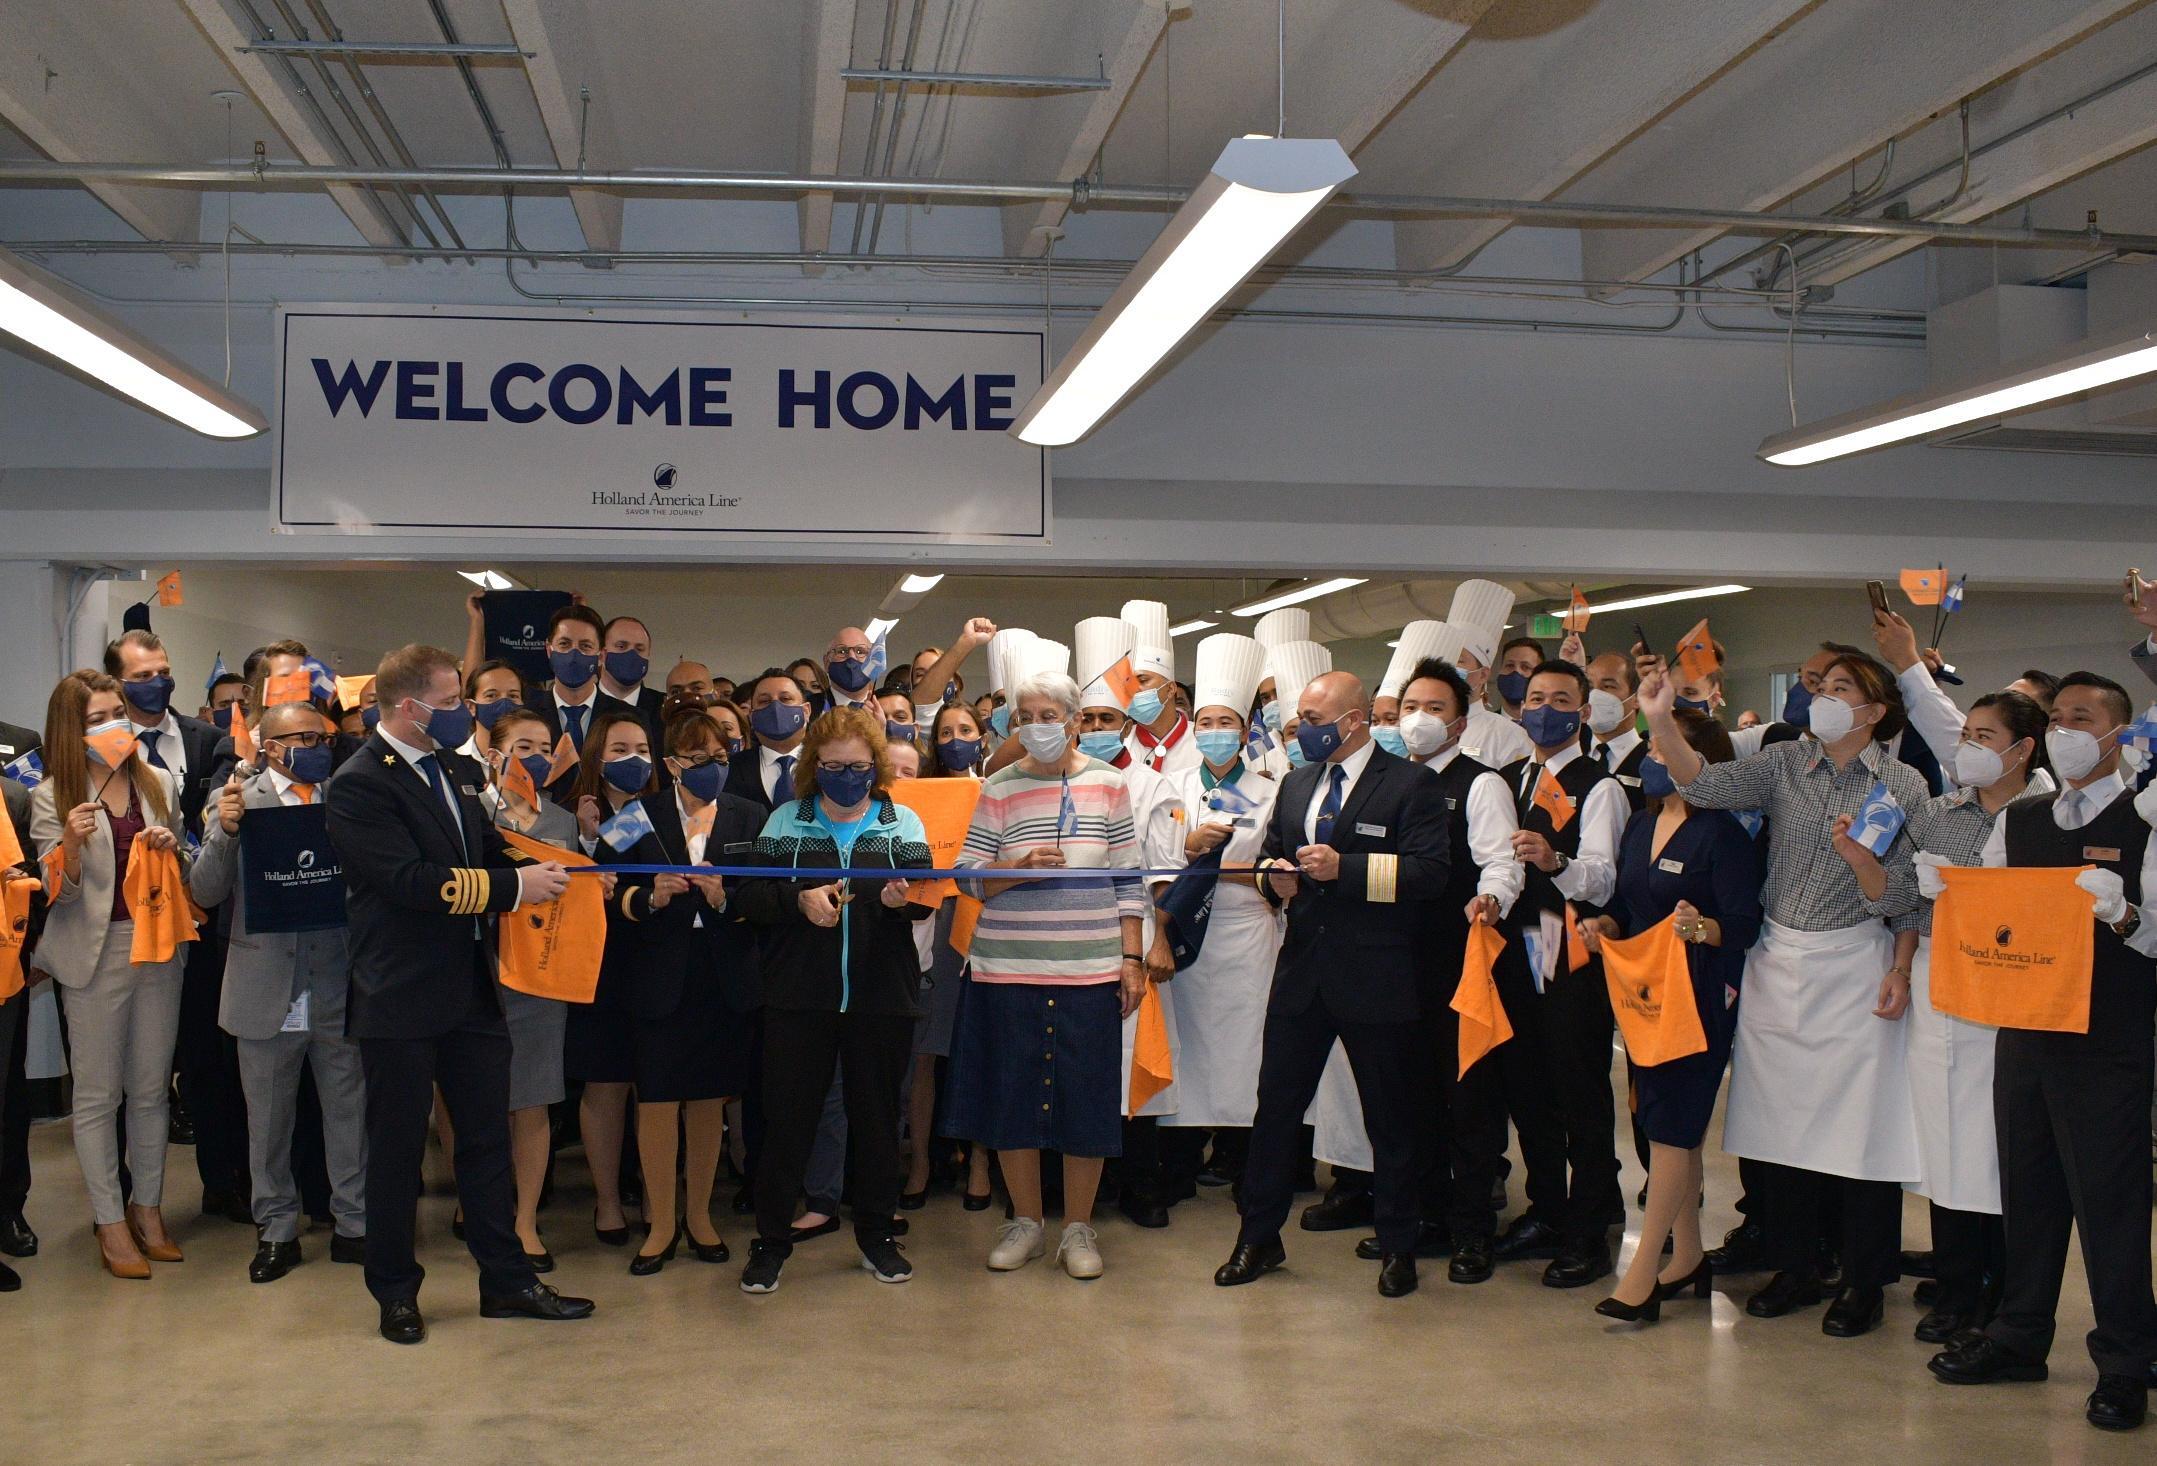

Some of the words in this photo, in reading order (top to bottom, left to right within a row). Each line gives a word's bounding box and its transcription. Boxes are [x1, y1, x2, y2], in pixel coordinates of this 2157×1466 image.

[310, 357, 733, 428] WELCOME
[778, 369, 1016, 431] HOME
[592, 491, 645, 506] Holland
[650, 492, 705, 507] America
[625, 508, 650, 516] SAVOR
[669, 509, 704, 517] JOURNEY
[264, 870, 295, 881] Holland
[296, 869, 333, 880] America
[333, 865, 342, 875] Li
[538, 936, 552, 971] Holland
[1991, 948, 2031, 963] America
